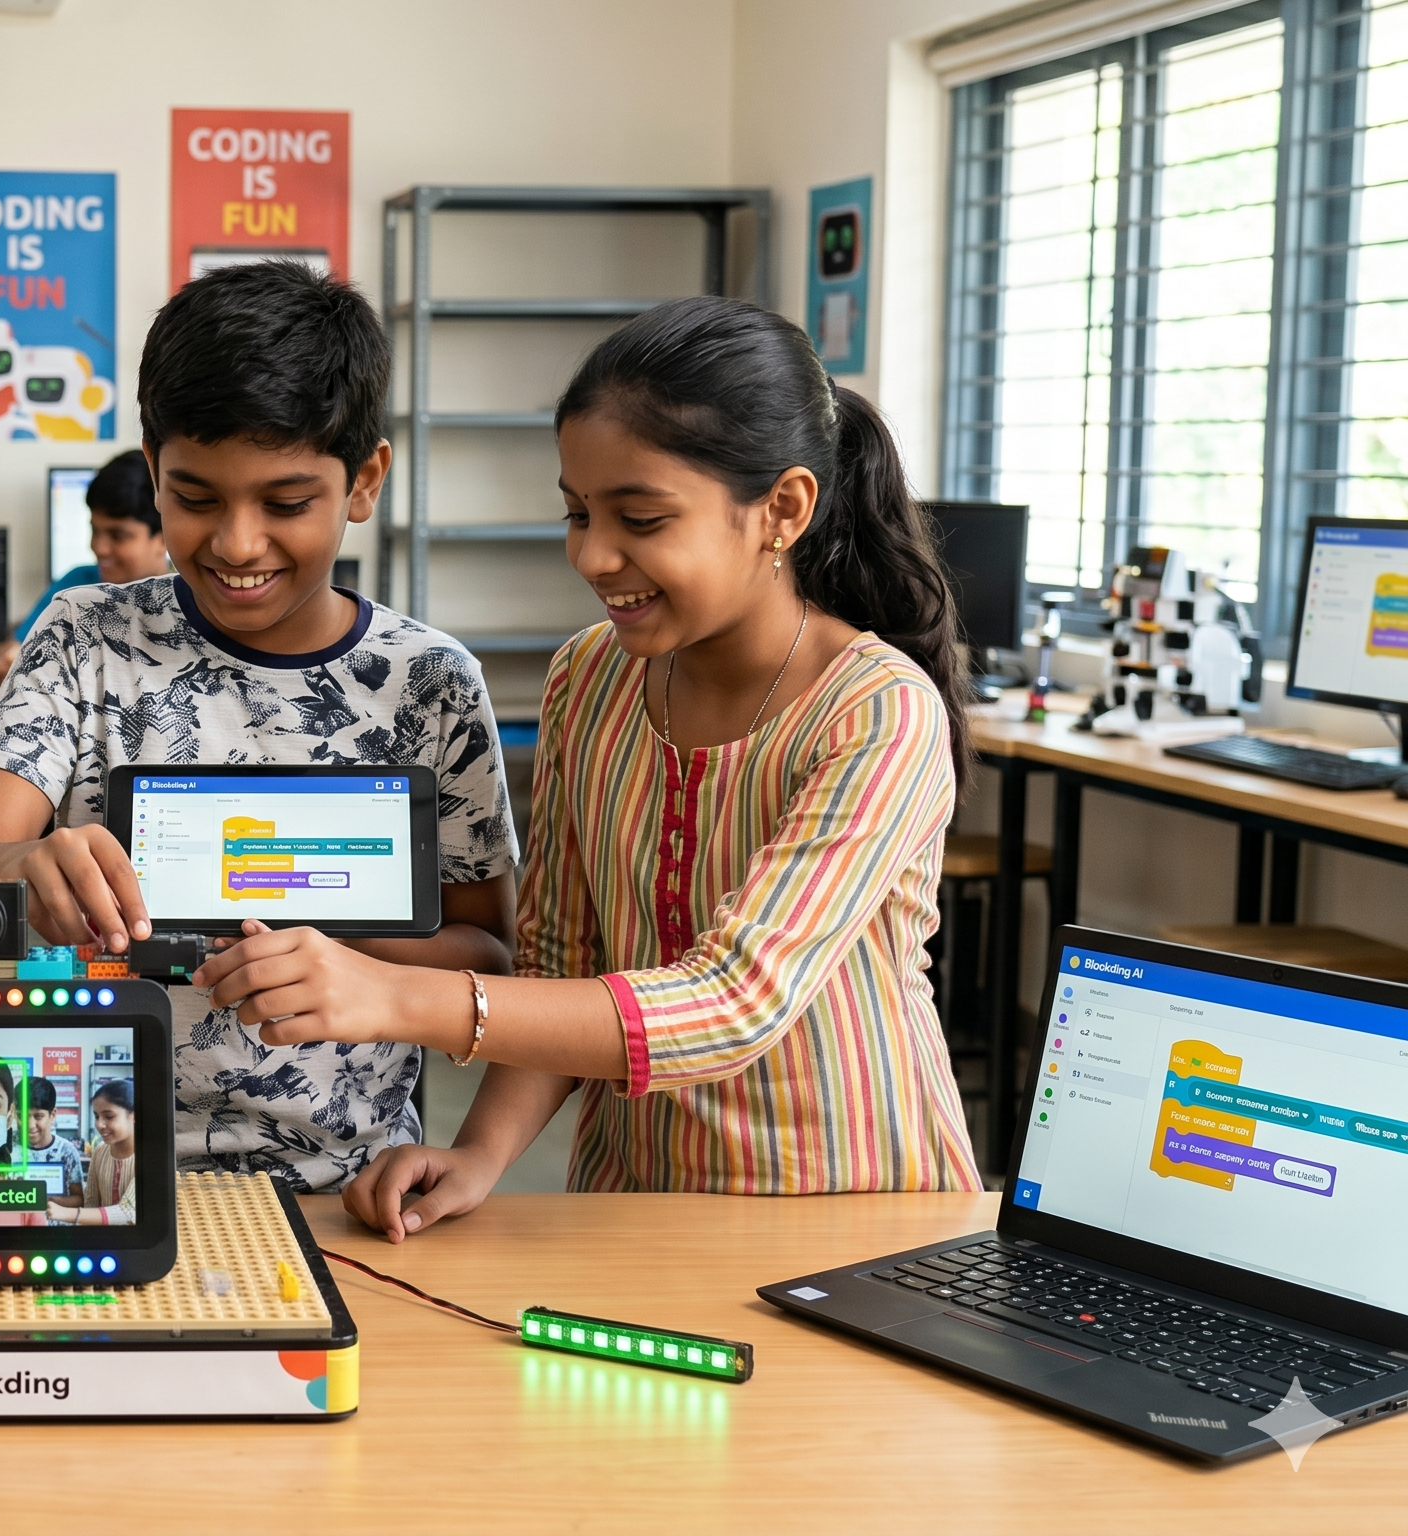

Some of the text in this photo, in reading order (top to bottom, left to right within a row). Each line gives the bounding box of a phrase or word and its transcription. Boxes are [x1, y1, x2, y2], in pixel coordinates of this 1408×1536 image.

[188, 127, 332, 164] CODING
[243, 166, 277, 200] IS
[222, 202, 297, 236] FUN
[7, 234, 44, 271] IS
[1084, 958, 1143, 979] Blockding AI
